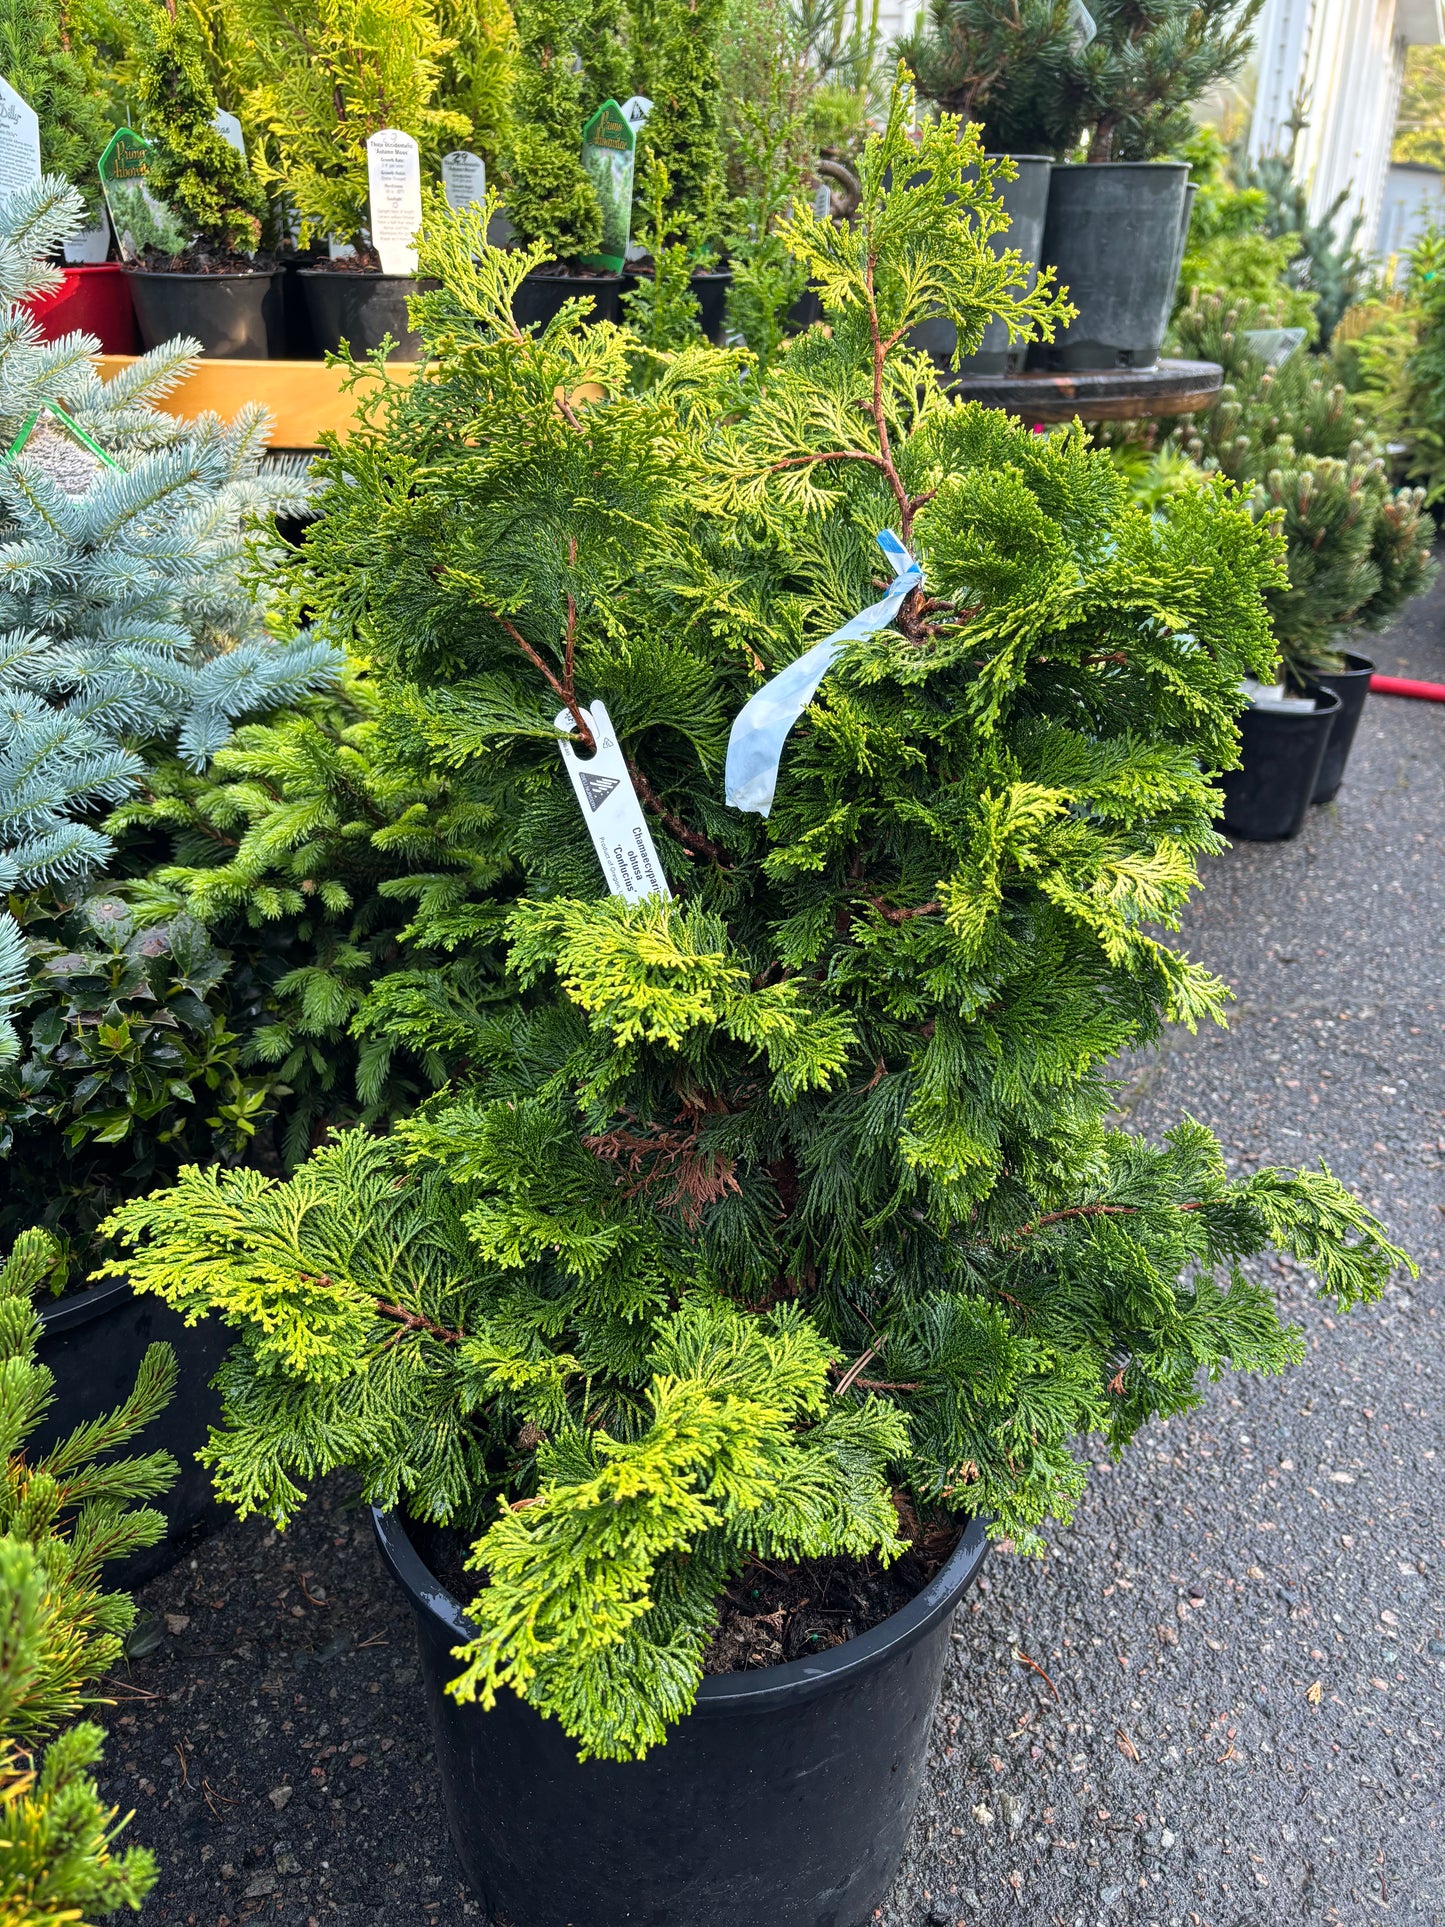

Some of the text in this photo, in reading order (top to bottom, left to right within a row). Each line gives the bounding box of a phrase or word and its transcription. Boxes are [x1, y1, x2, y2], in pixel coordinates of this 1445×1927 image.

[452, 152, 468, 163] 29
[599, 836, 611, 859] Product
[627, 850, 643, 881] obtusa
